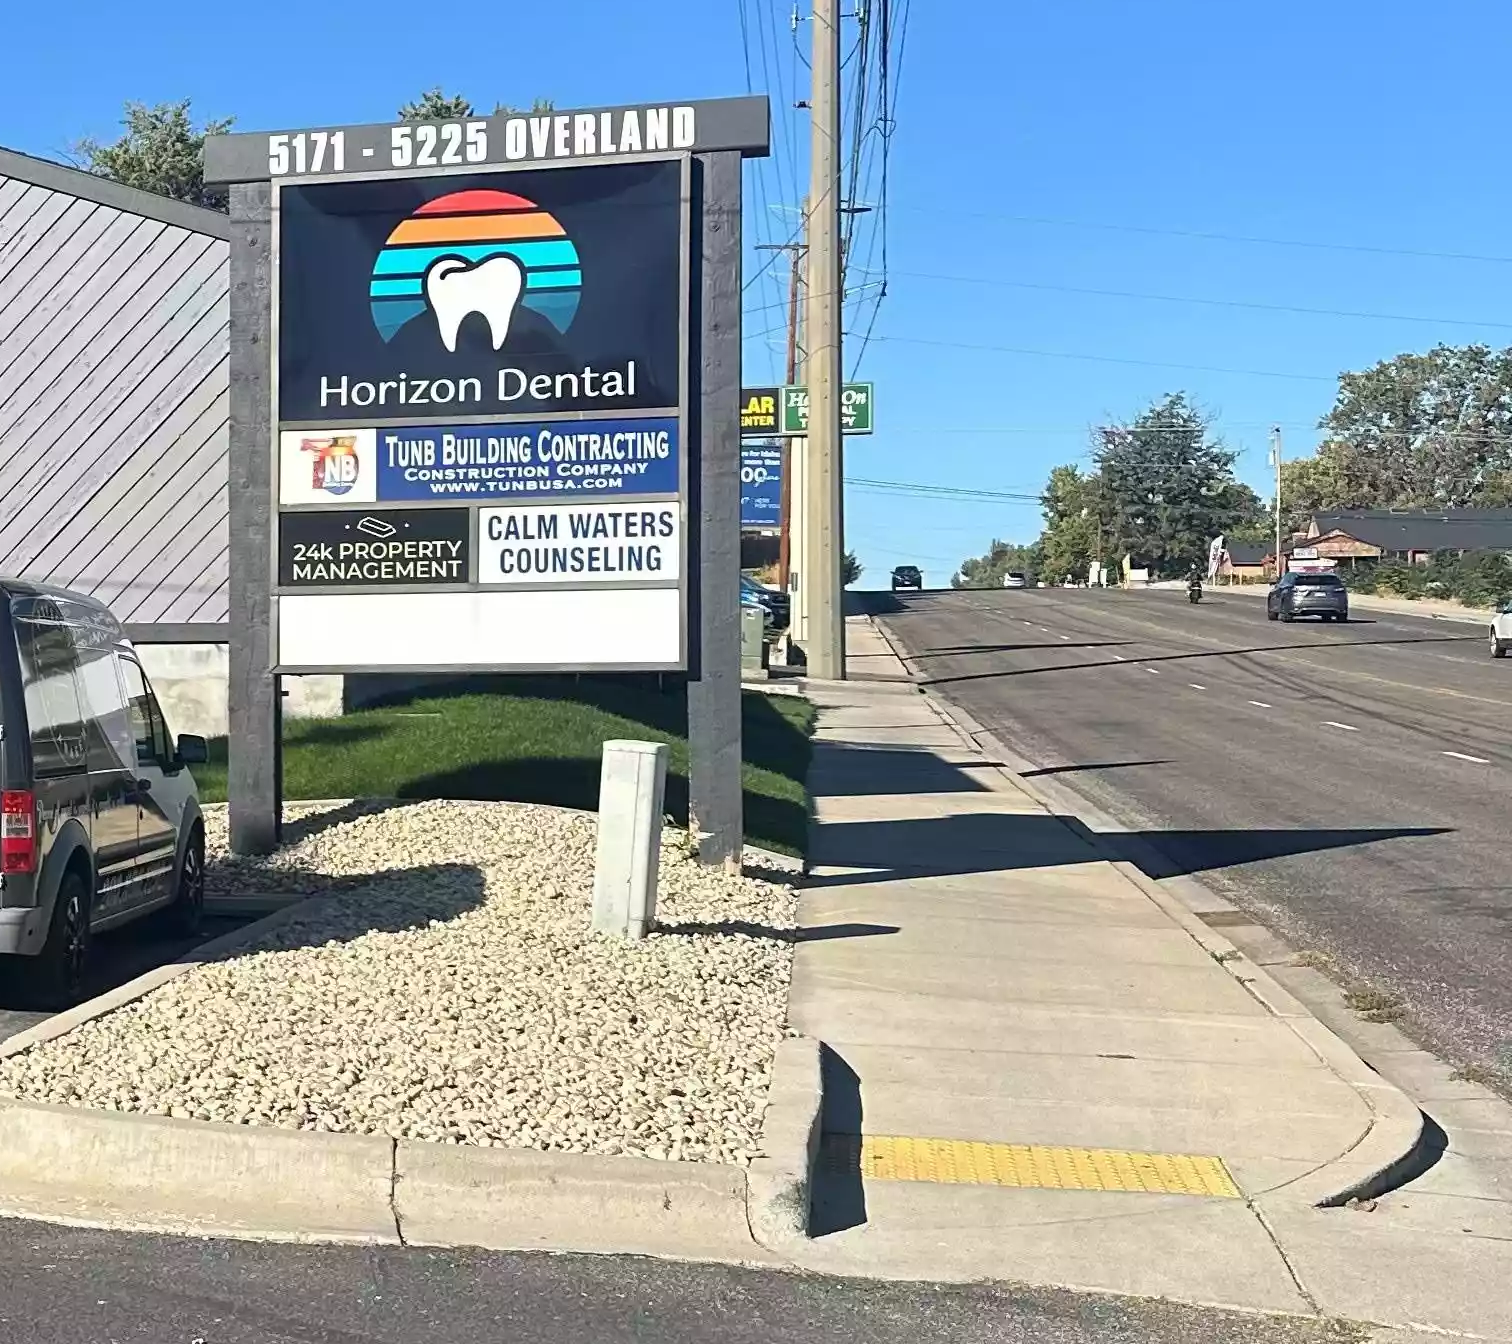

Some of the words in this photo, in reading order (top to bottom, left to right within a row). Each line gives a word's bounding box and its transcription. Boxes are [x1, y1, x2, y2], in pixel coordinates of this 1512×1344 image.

[269, 131, 345, 175] 5171
[362, 148, 374, 157] -
[391, 121, 488, 167] 5225
[505, 106, 695, 160] OVERLAND
[320, 372, 482, 407] Horizon
[498, 360, 635, 401] Dental
[386, 435, 435, 467] TUNB
[442, 433, 531, 465] BUILDING
[537, 430, 669, 463] CONTRACTING
[404, 466, 549, 482] CONSTRUCTION
[555, 462, 649, 477] COMPANY
[430, 477, 623, 493] WWW.TUNBUSA.COM
[488, 515, 558, 540] CALM
[569, 511, 674, 538] WATERS
[293, 543, 333, 561] 24k
[339, 540, 462, 560] PROPERTY
[499, 545, 662, 574] COUNSELING
[293, 560, 462, 581] MANAGEMENT
